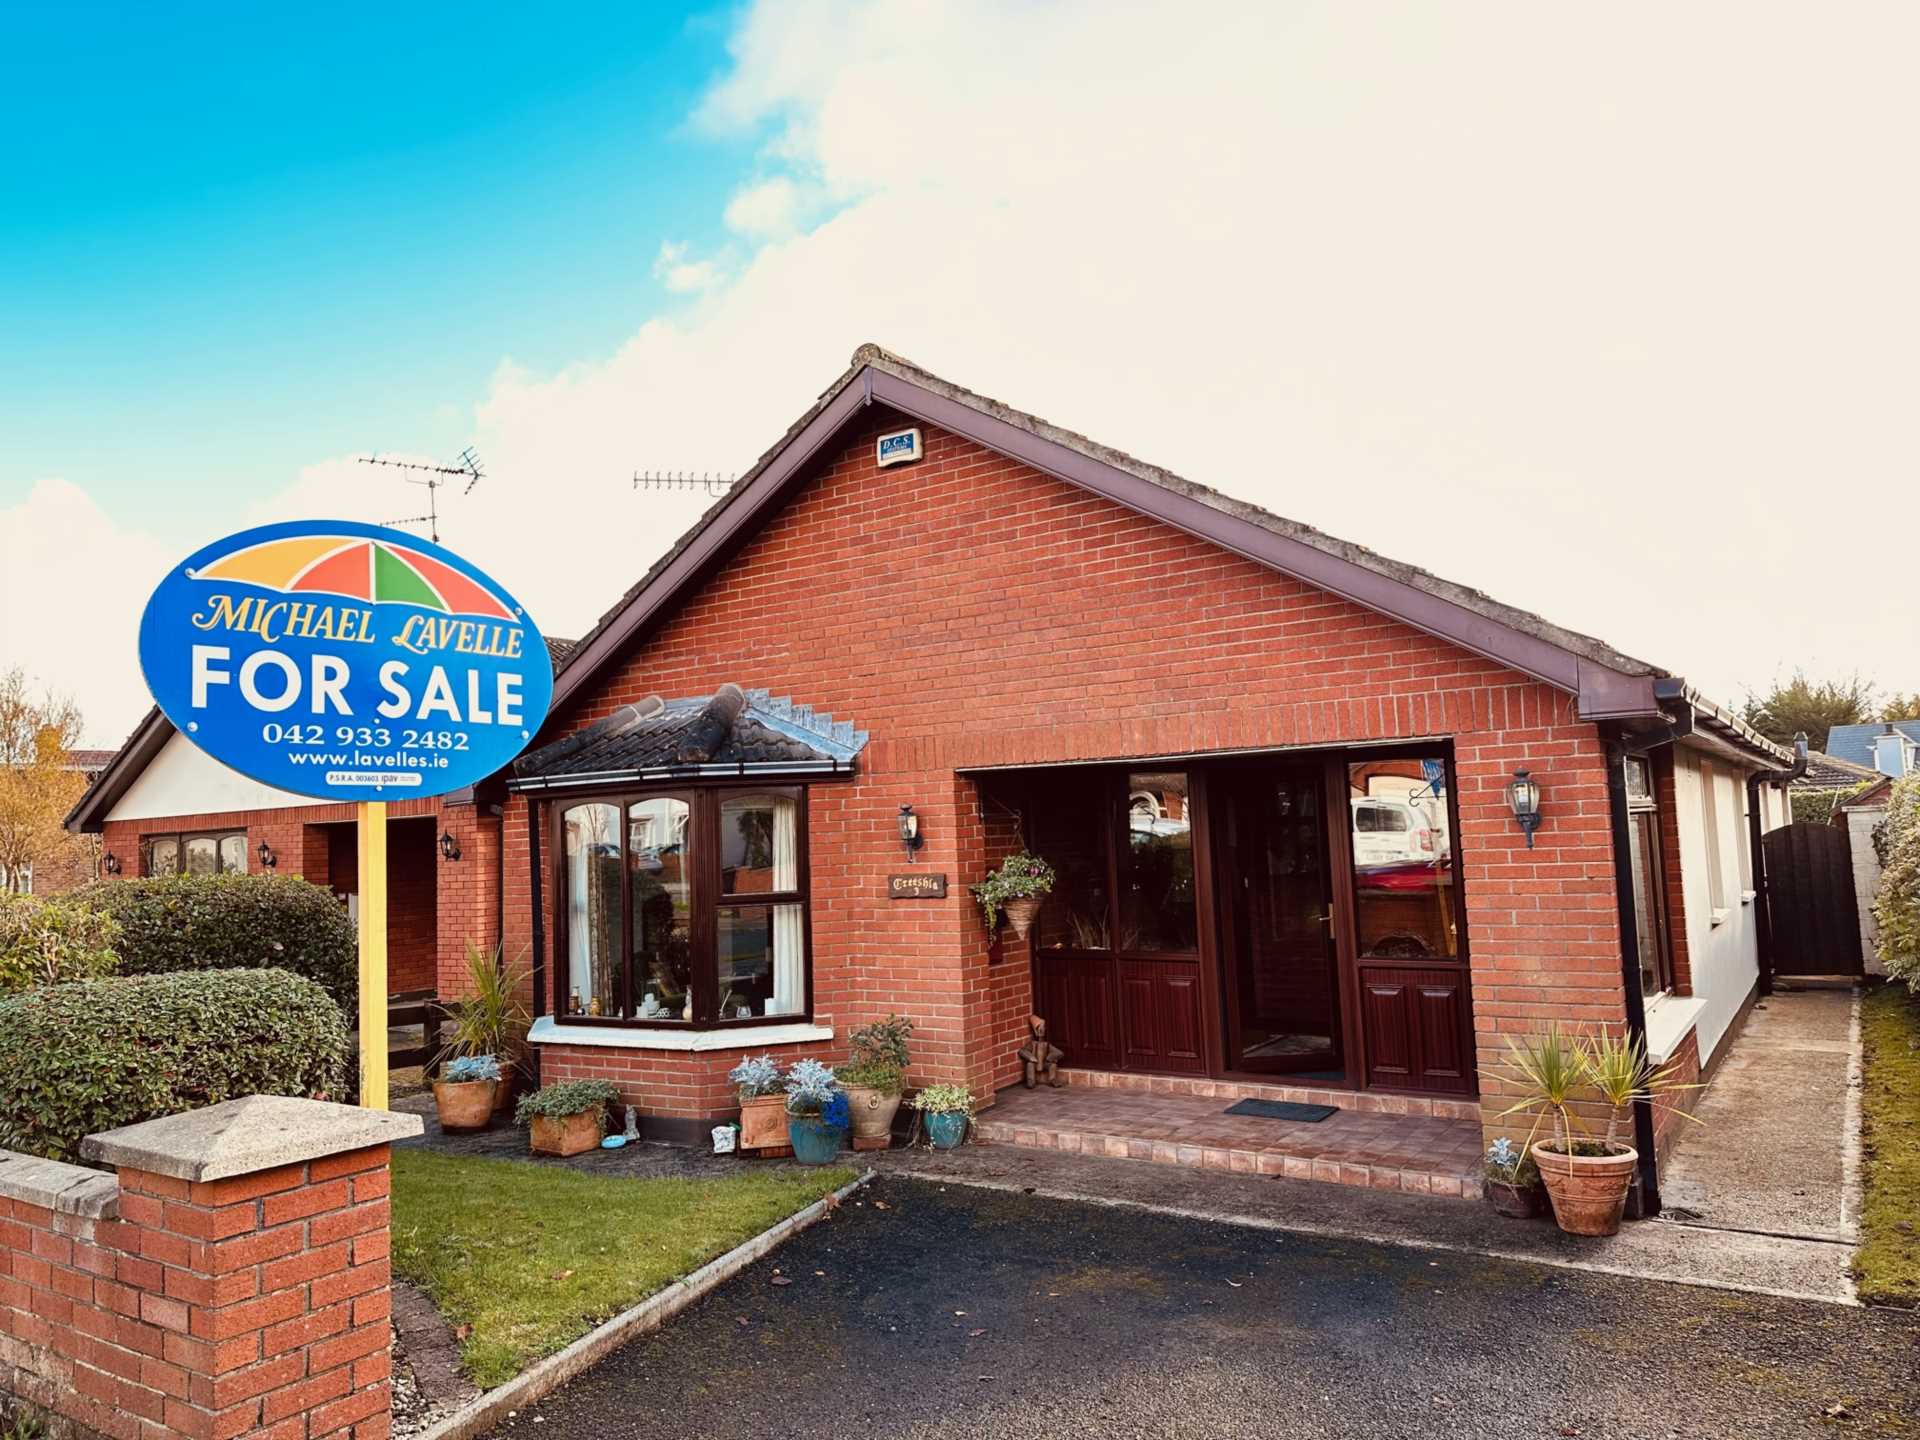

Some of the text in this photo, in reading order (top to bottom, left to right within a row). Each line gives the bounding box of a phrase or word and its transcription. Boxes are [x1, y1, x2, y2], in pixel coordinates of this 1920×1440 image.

[192, 595, 524, 658] MICHAEL LAVELLE
[192, 644, 523, 726] FOR SALE
[262, 723, 469, 750] 042 933 2482
[288, 750, 449, 768] www.lavelles.ie
